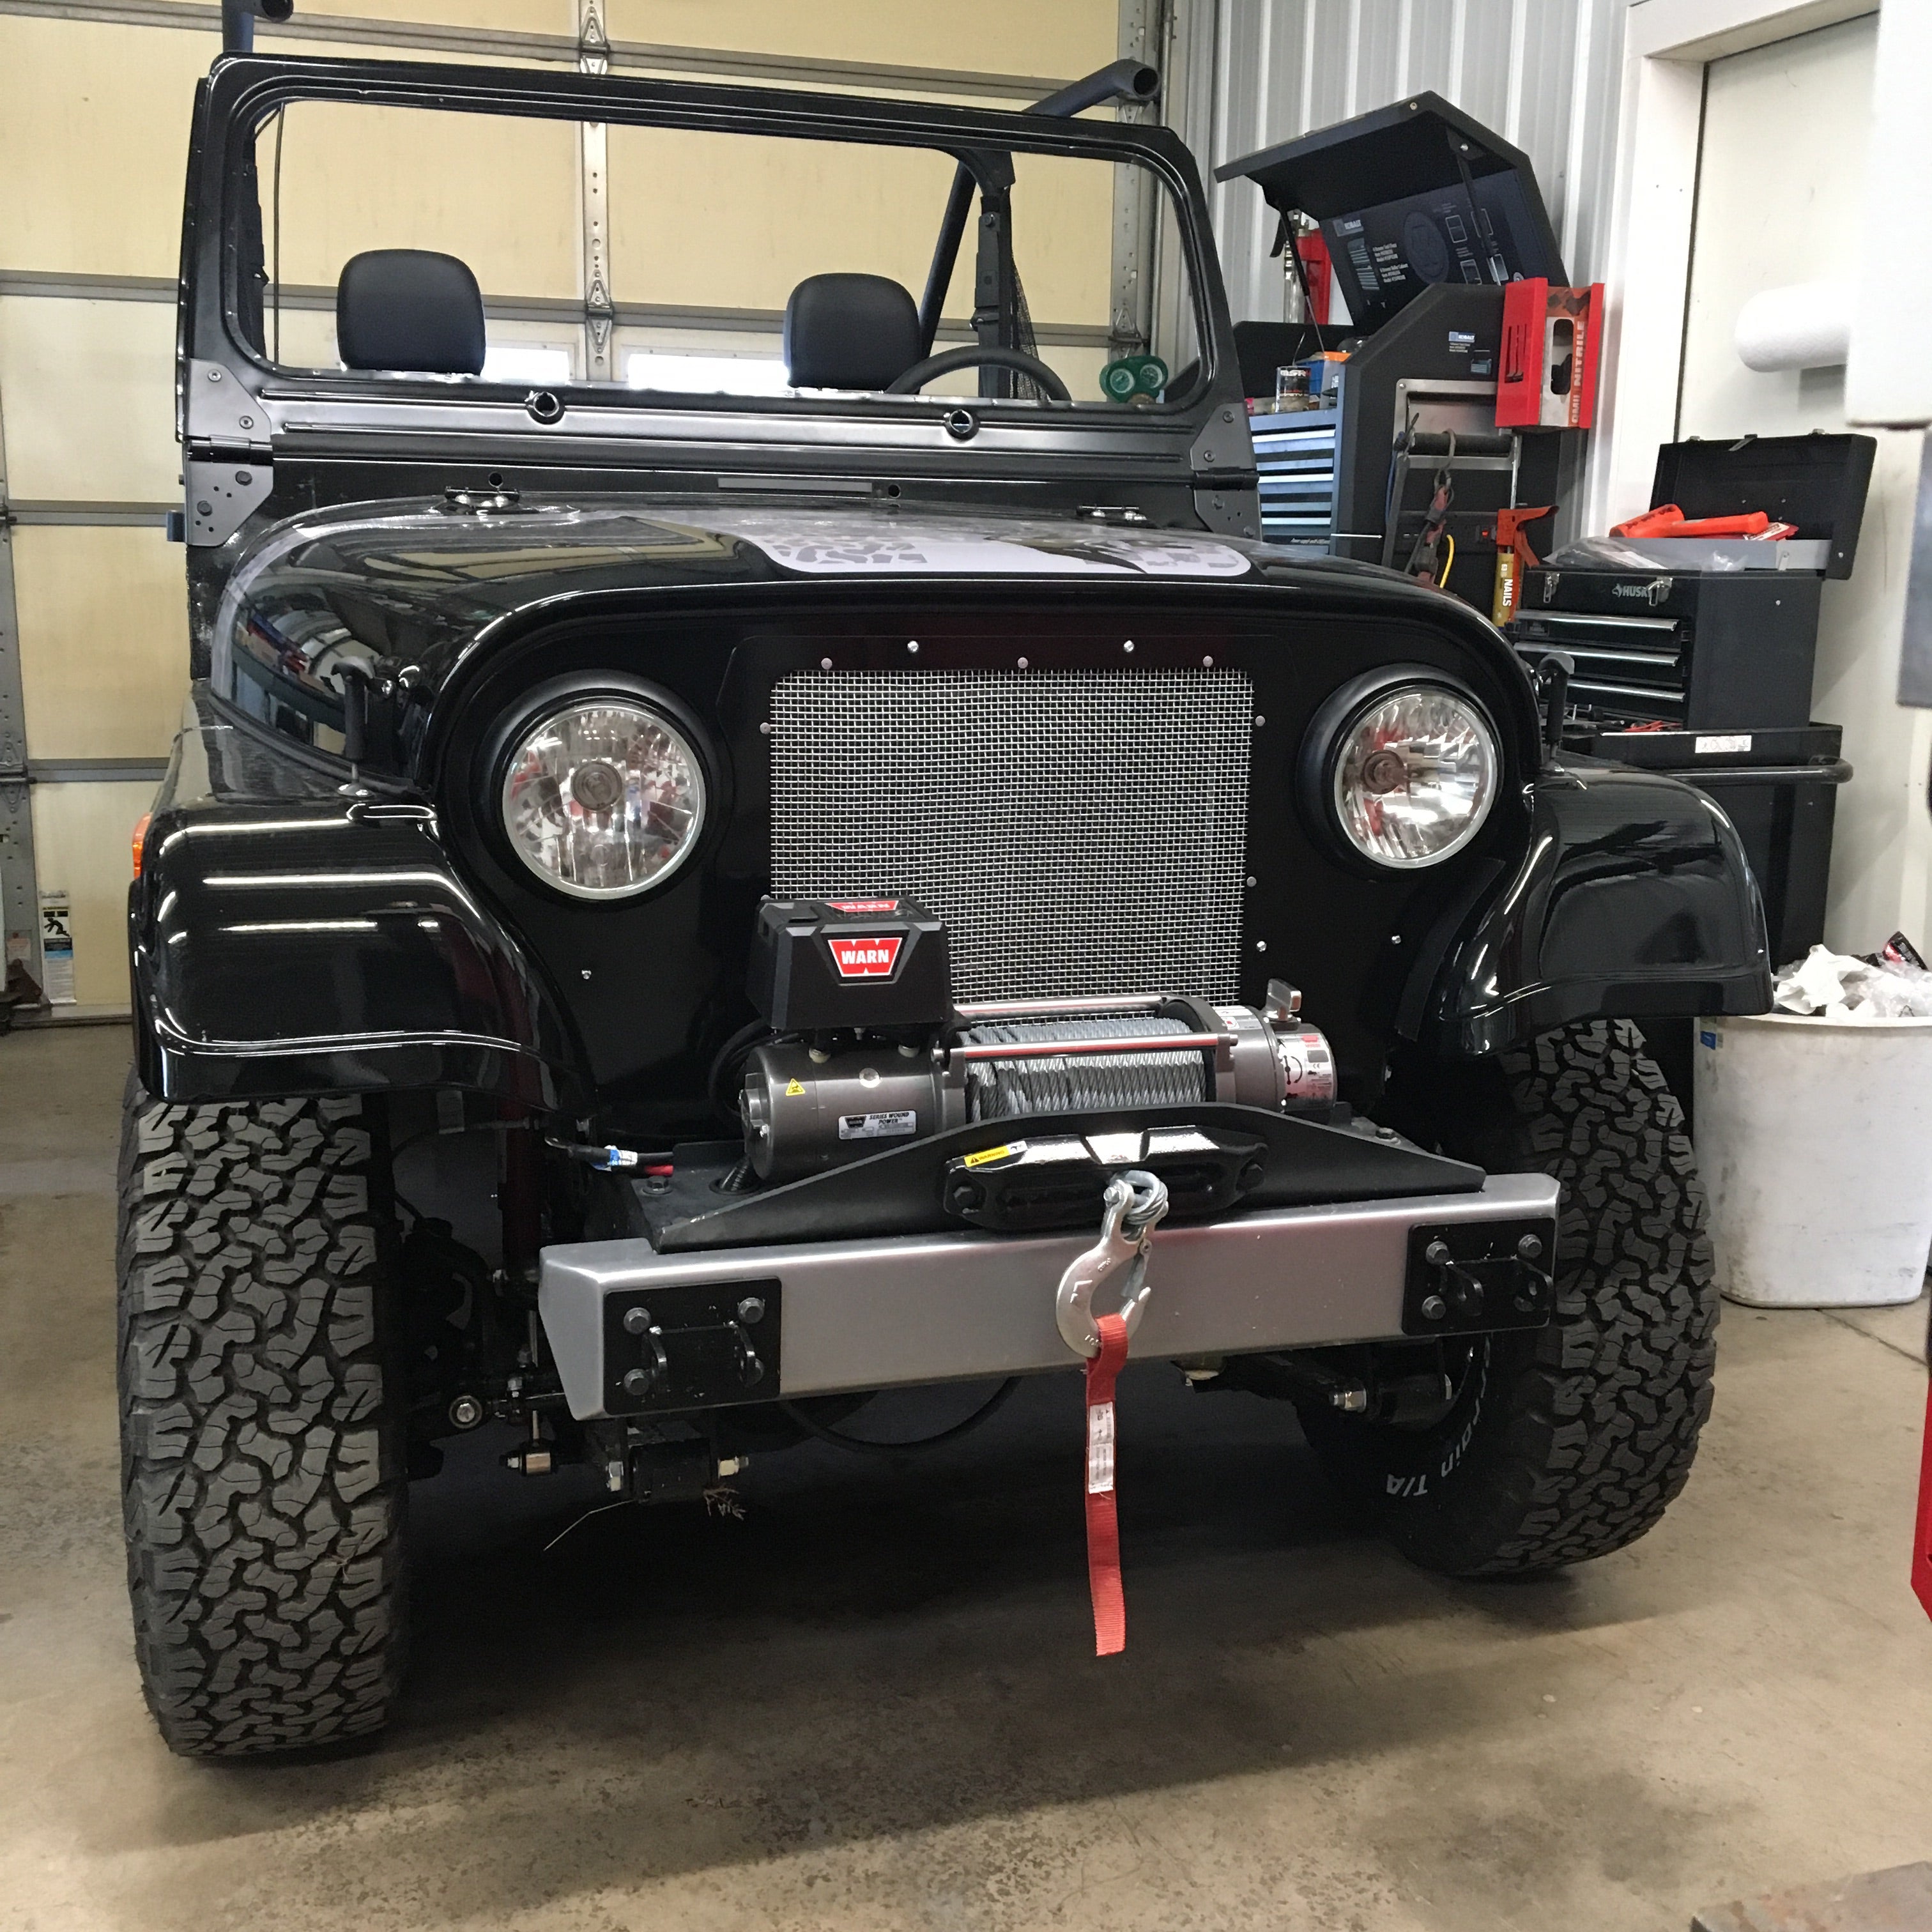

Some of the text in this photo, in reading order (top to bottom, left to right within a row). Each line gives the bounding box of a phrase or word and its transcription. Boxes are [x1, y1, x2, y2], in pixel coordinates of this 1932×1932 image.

[1574, 321, 1586, 387] NITRILE
[1502, 578, 1514, 606] NAILS
[841, 949, 889, 965] WARN
[978, 1150, 1005, 1160] WARNING
[1385, 1473, 1429, 1497] T/A
